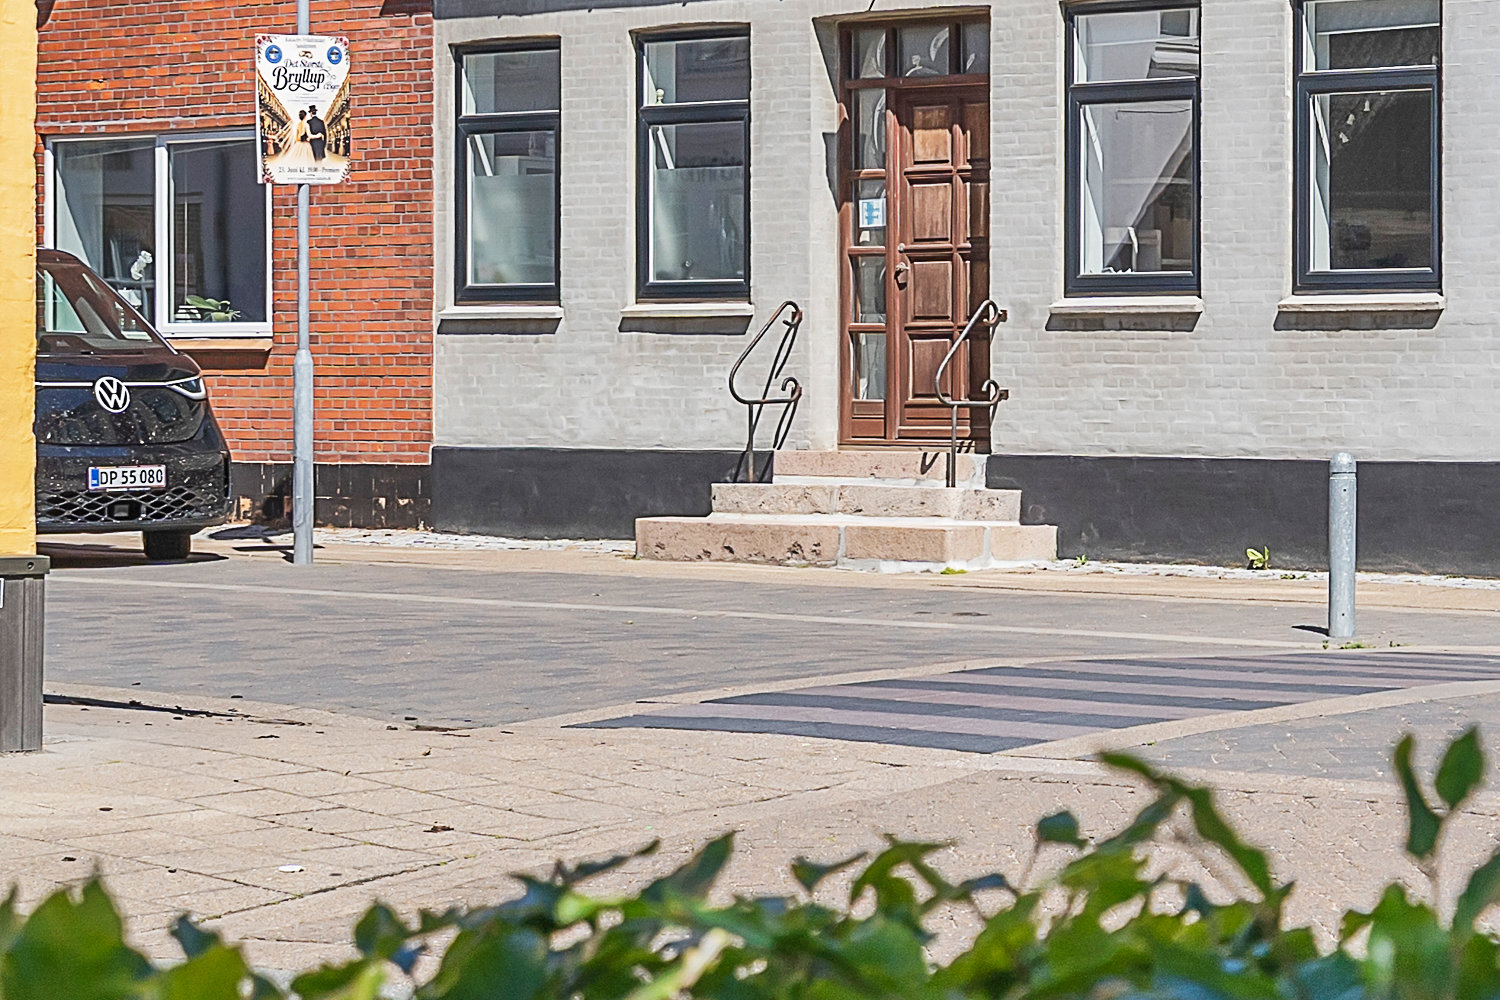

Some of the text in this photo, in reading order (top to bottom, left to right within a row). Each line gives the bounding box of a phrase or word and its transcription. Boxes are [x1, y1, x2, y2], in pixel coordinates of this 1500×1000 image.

[272, 65, 325, 92] Bryllup
[100, 468, 163, 485] DP 55 080
